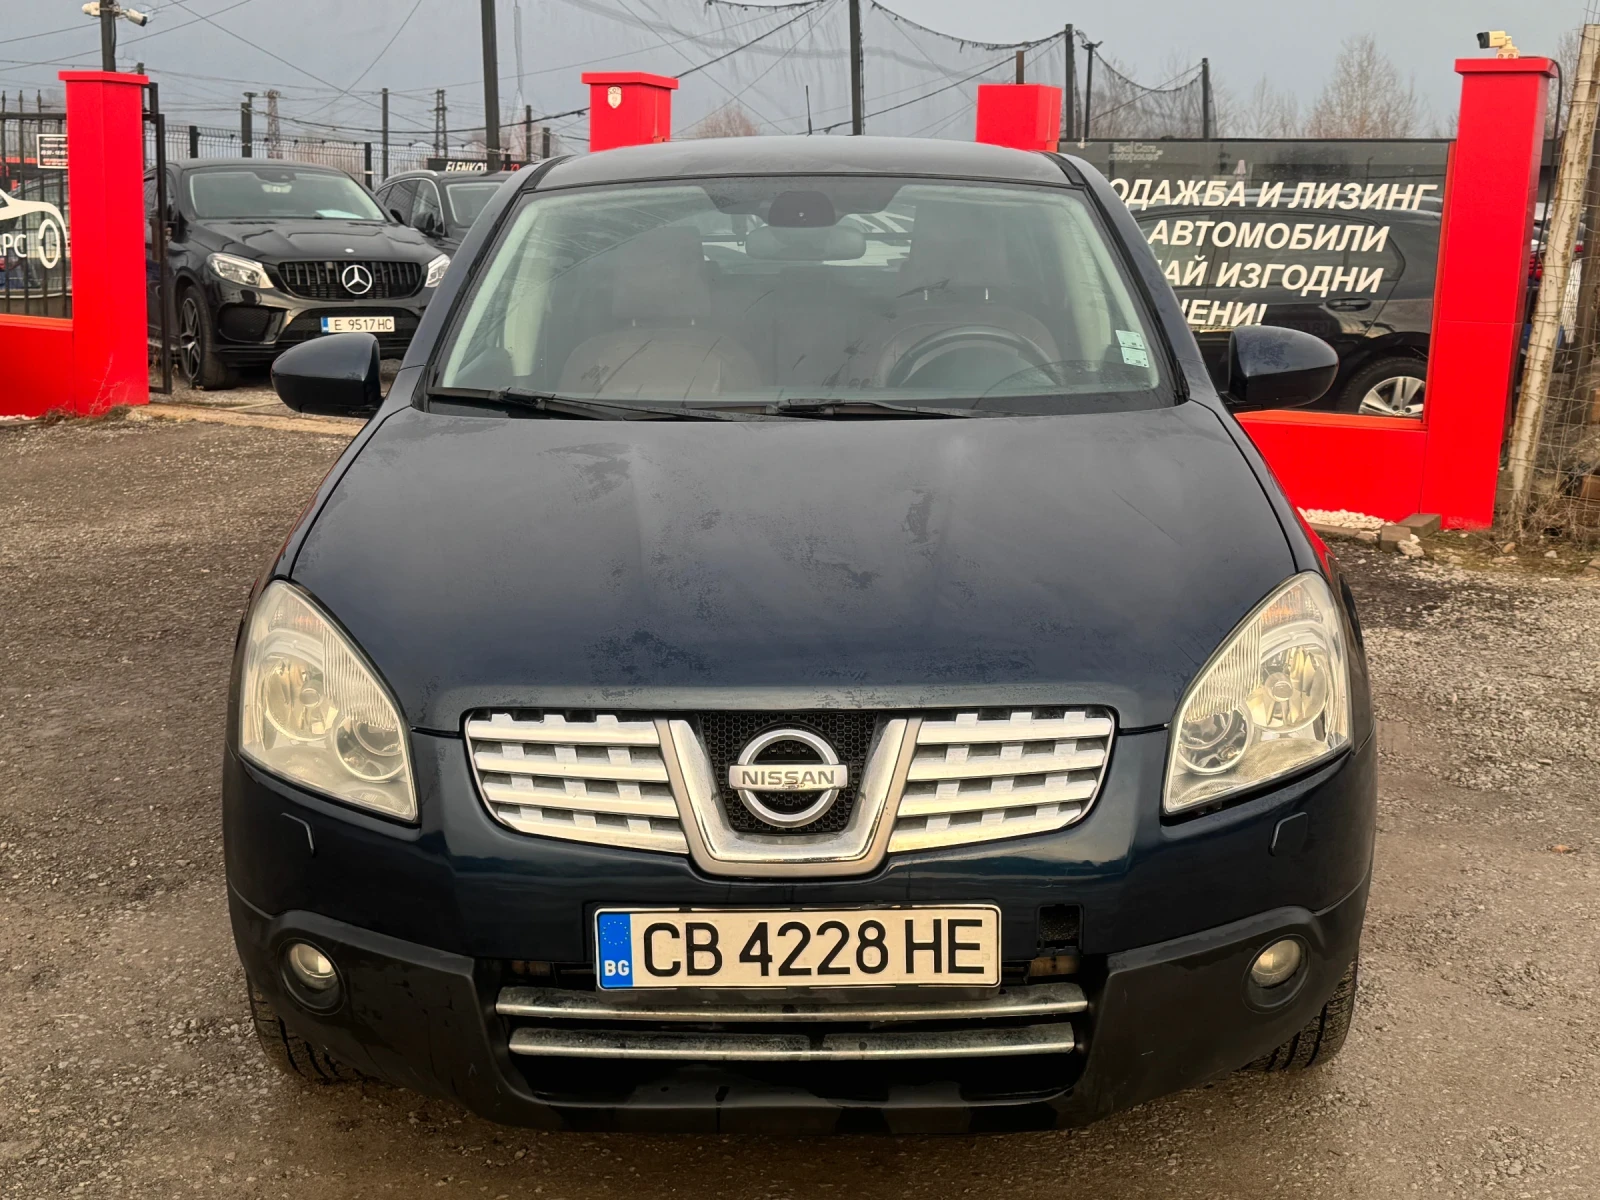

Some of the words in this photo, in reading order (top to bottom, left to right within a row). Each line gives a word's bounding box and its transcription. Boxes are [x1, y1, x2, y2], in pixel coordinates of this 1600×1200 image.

[1256, 181, 1284, 207] И
[1288, 182, 1438, 210] ЛИЗИНГ
[1148, 219, 1390, 252] АВТОМОБИЛИ
[1216, 262, 1384, 297] ИЗГОДНИ
[348, 318, 376, 331] 9517
[377, 318, 392, 330] HC
[742, 769, 835, 786] NISSAN
[643, 921, 723, 977] CB
[738, 919, 889, 977] 4228
[904, 918, 985, 975] HE
[604, 960, 630, 977] BG
